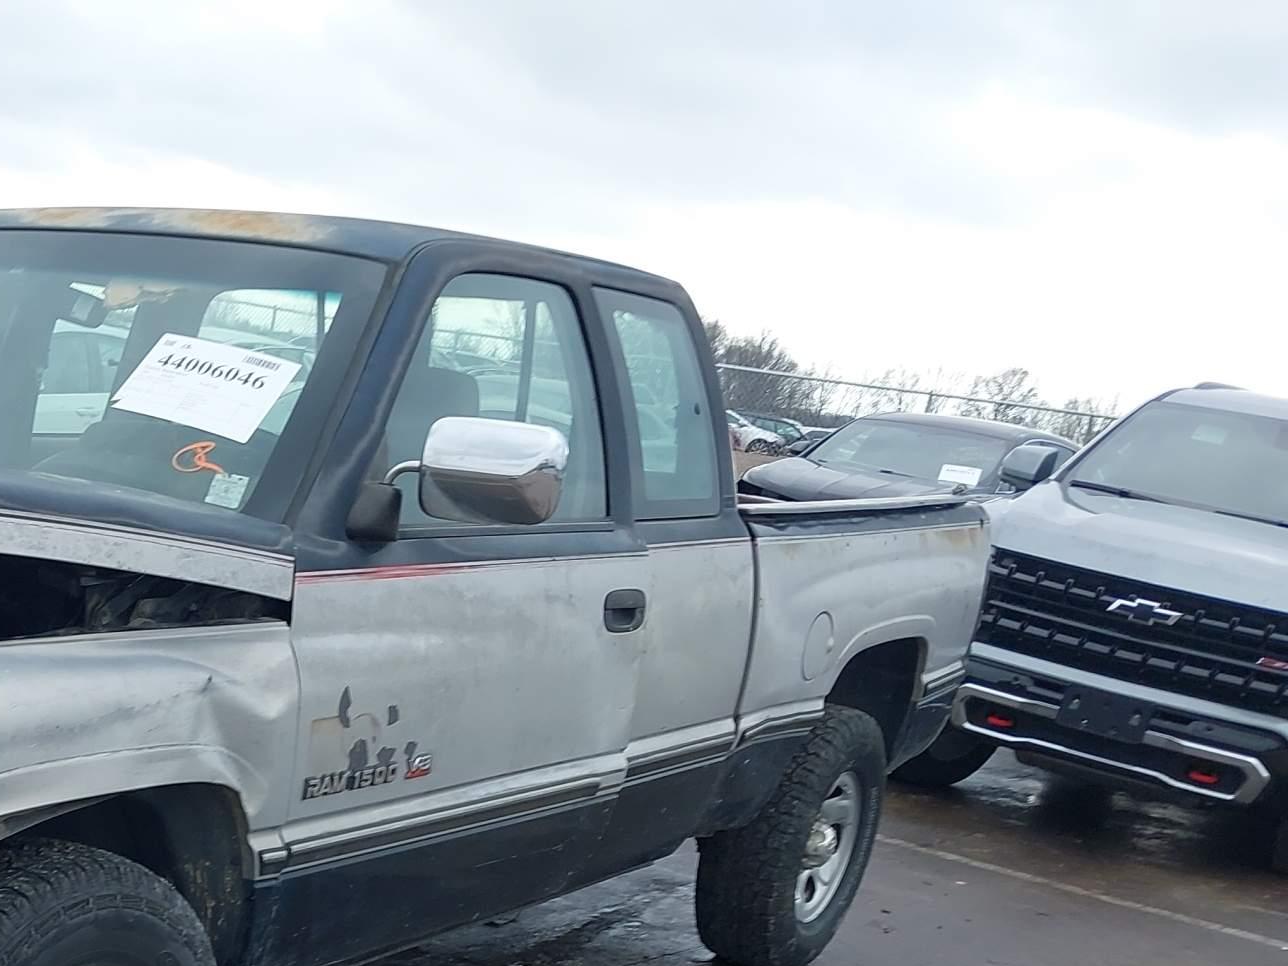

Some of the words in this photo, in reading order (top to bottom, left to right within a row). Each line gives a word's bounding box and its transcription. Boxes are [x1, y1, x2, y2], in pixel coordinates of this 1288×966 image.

[158, 353, 267, 389] 44006046
[304, 772, 349, 799] RAM
[353, 764, 400, 790] 1500
